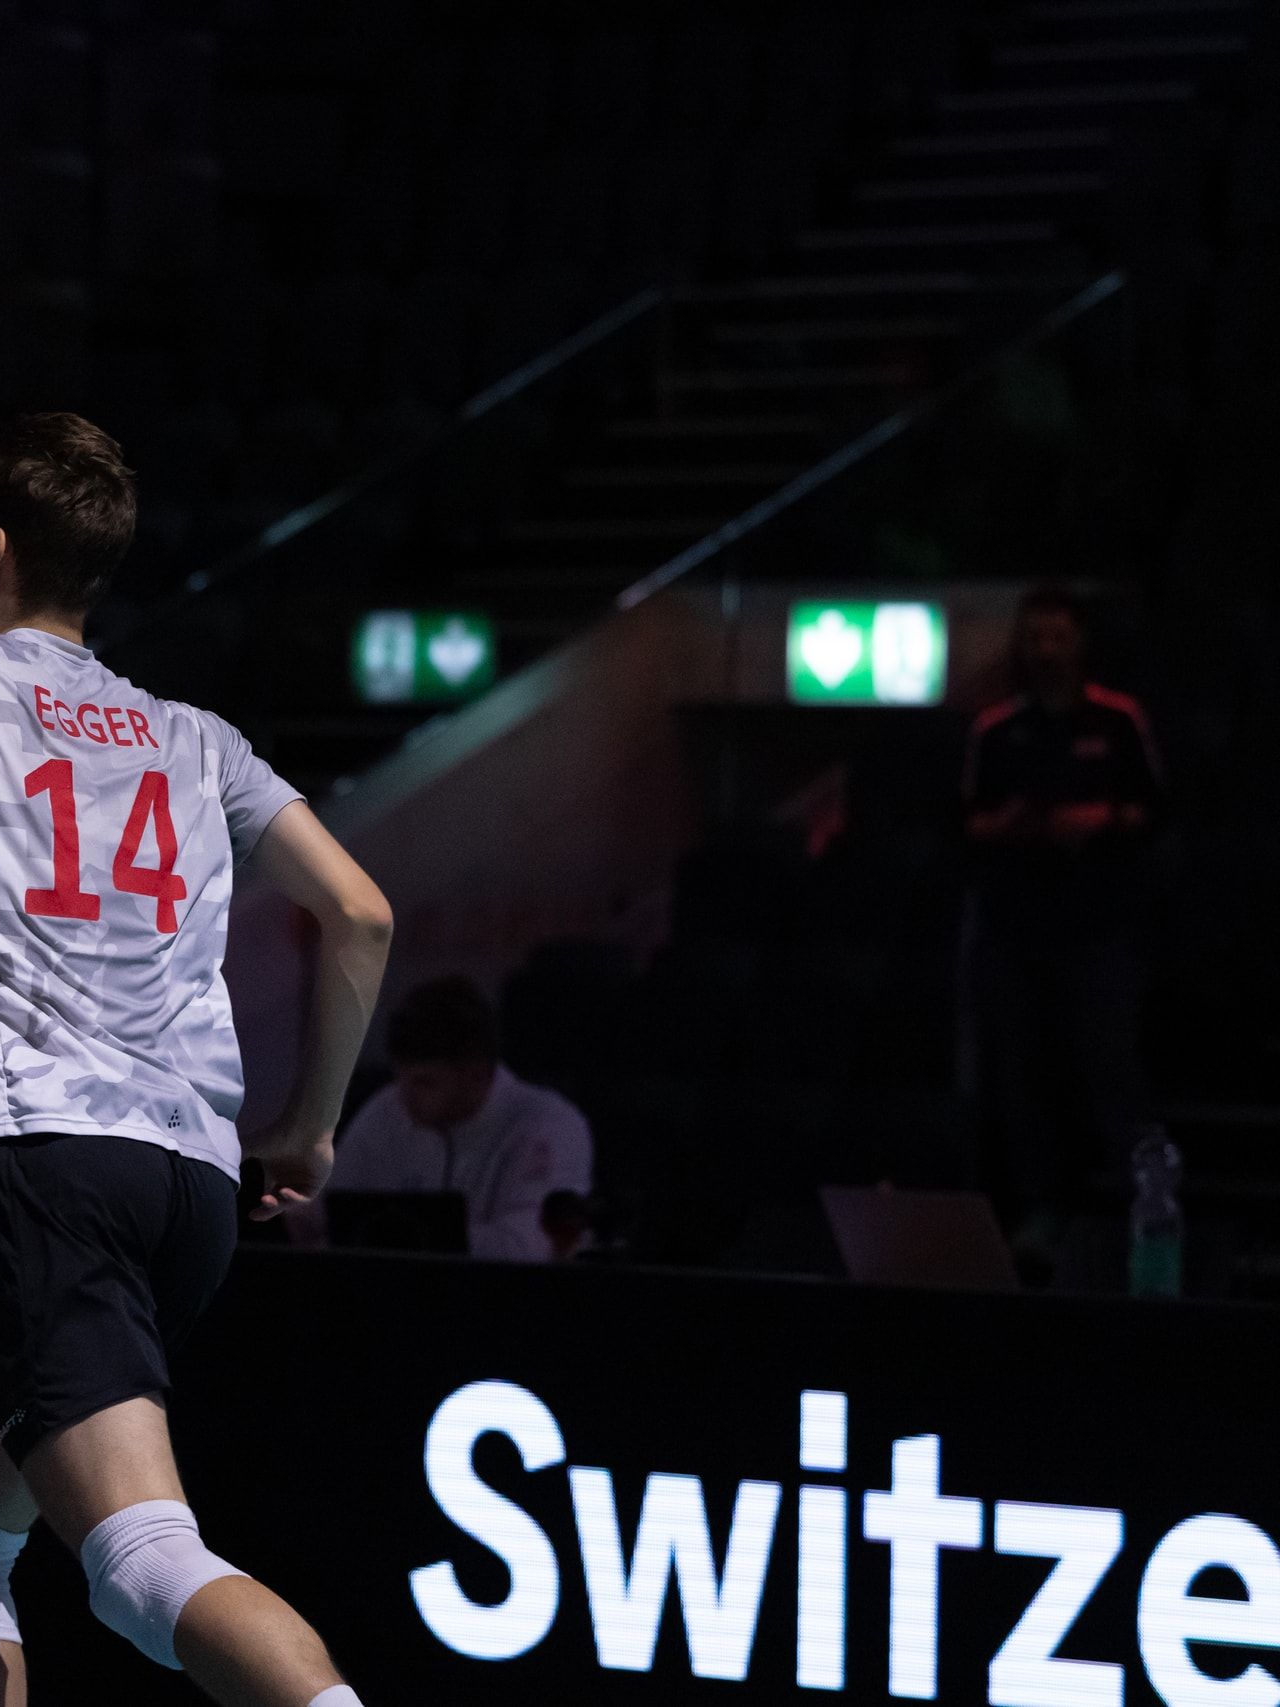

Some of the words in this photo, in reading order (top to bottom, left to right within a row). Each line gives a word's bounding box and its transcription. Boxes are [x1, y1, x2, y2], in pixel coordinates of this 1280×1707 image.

[34, 684, 158, 748] EGGER
[23, 758, 188, 934] 14
[409, 1380, 1280, 1707] Switze
